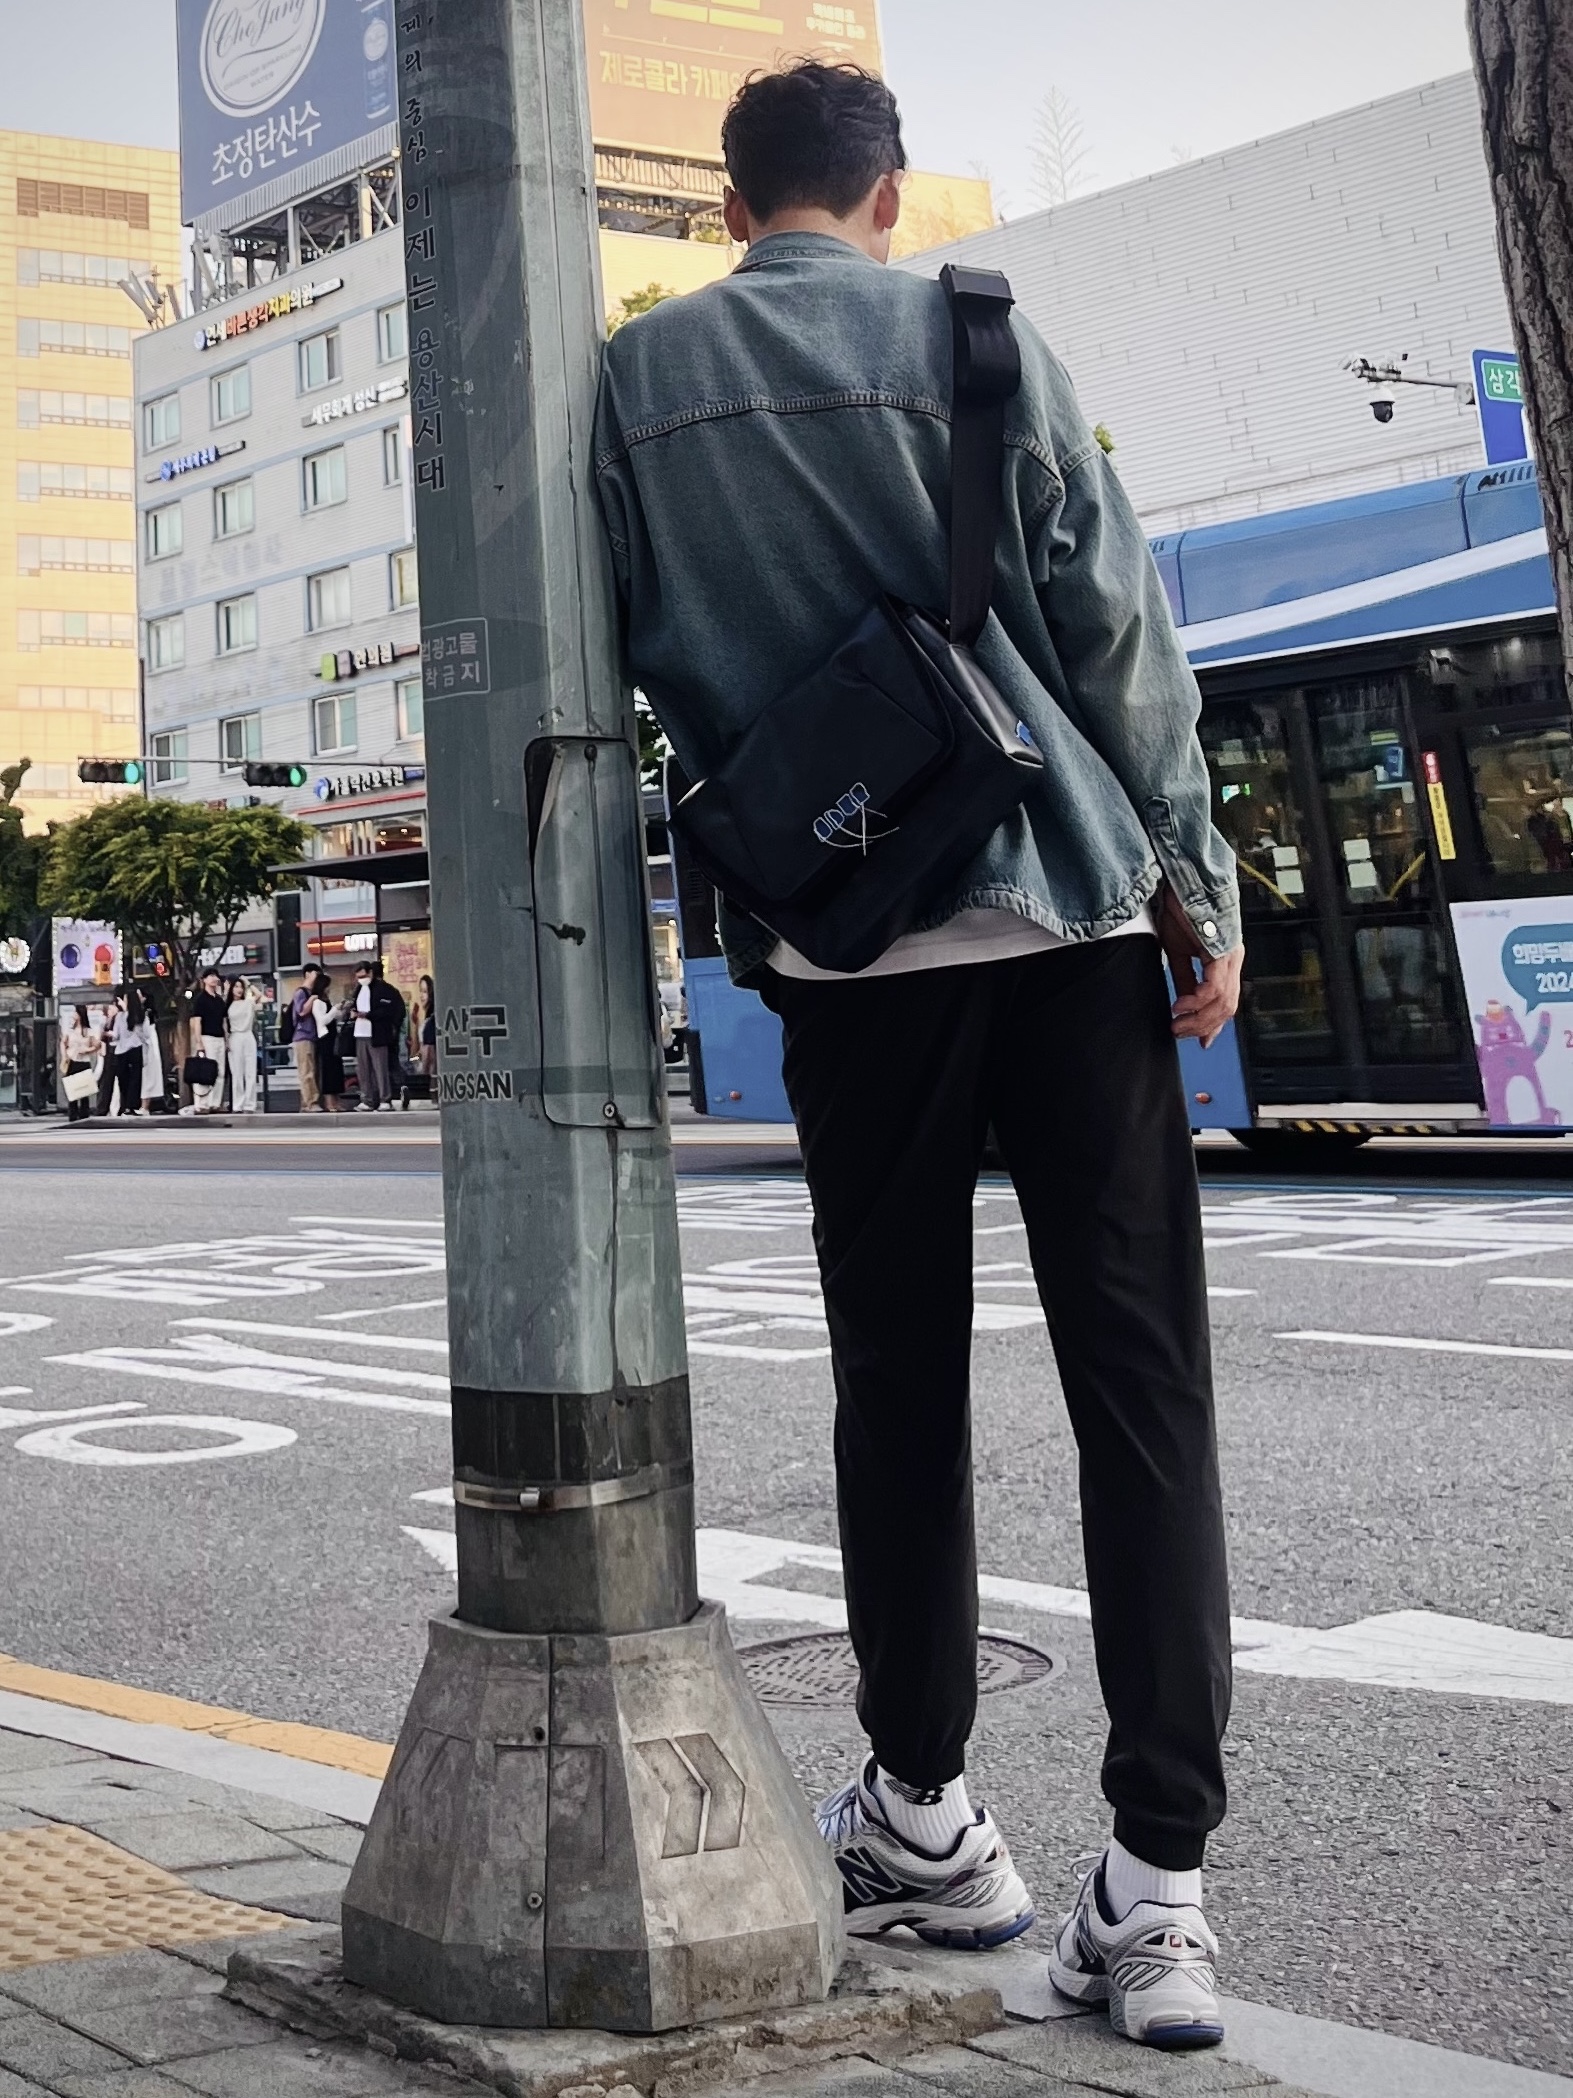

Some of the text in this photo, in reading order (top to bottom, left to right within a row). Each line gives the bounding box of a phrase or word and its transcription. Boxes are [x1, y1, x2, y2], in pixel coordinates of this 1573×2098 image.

[600, 51, 688, 96] 제로콜라
[212, 101, 322, 186] 초정탄산수
[405, 186, 436, 312] 이제는
[411, 328, 445, 492] 용산시대
